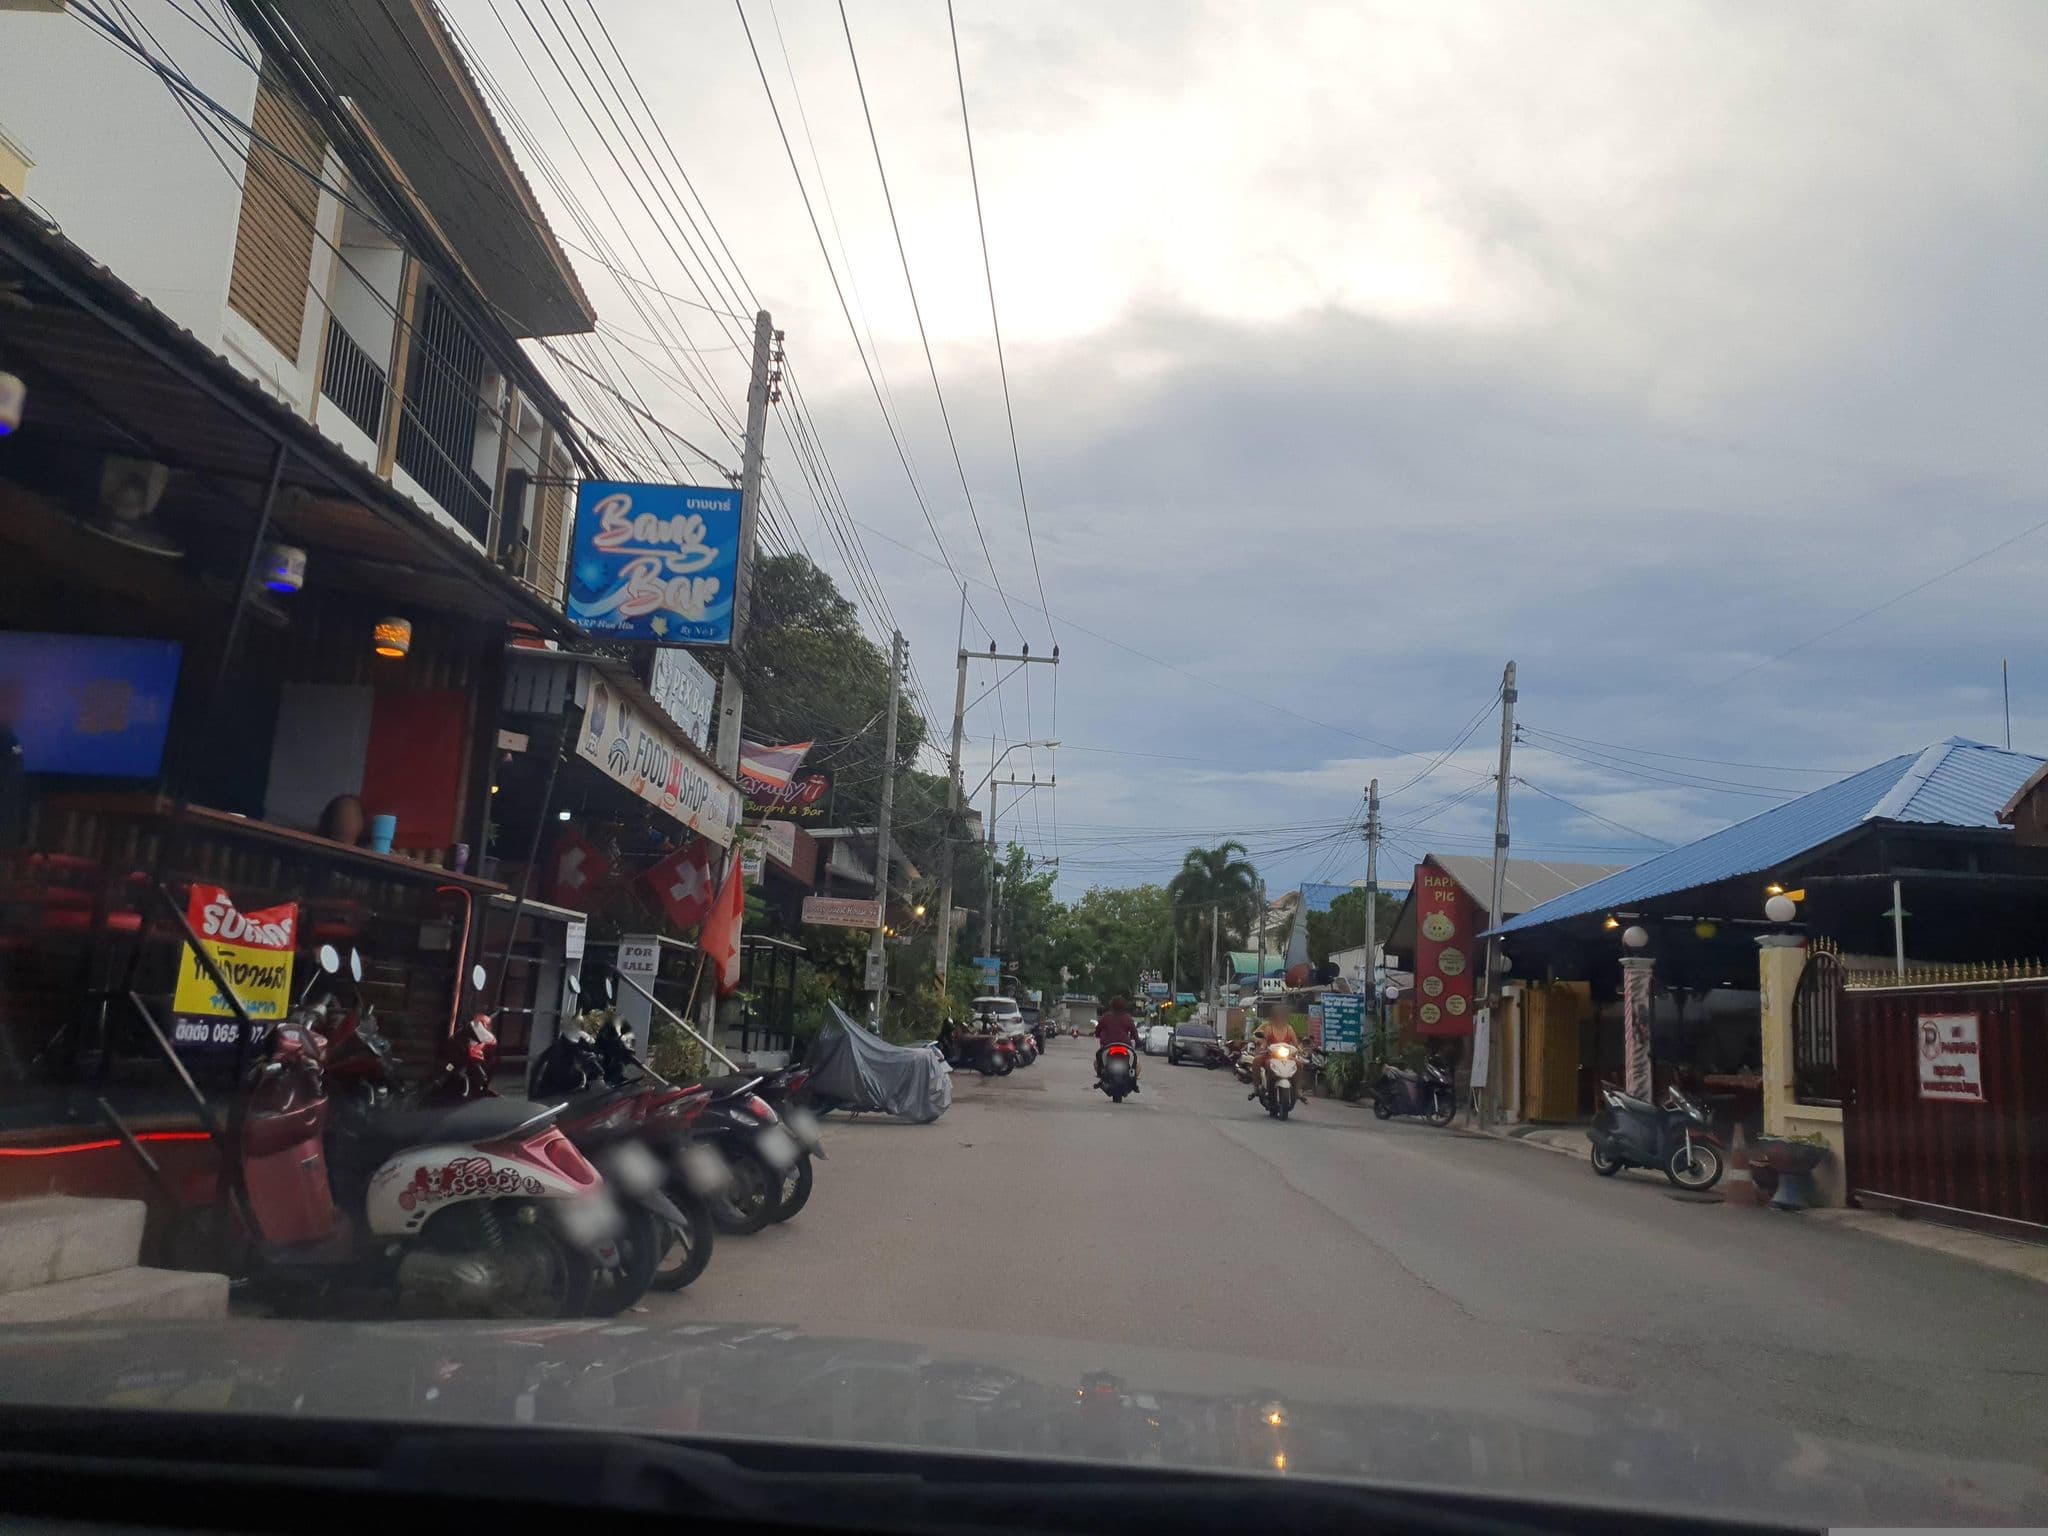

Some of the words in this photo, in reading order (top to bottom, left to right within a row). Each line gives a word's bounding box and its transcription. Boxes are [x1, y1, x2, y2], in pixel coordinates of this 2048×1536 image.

[686, 497, 732, 512] บางบาร์
[592, 493, 719, 574] Bang
[618, 556, 720, 617] Bar
[632, 729, 669, 789] FOOD
[679, 766, 710, 815] SHOP
[801, 806, 824, 816] Bar
[1434, 891, 1455, 902] PIG
[625, 947, 653, 957] FOR
[623, 961, 653, 972] SALE
[453, 1173, 521, 1195] SCOOPY
